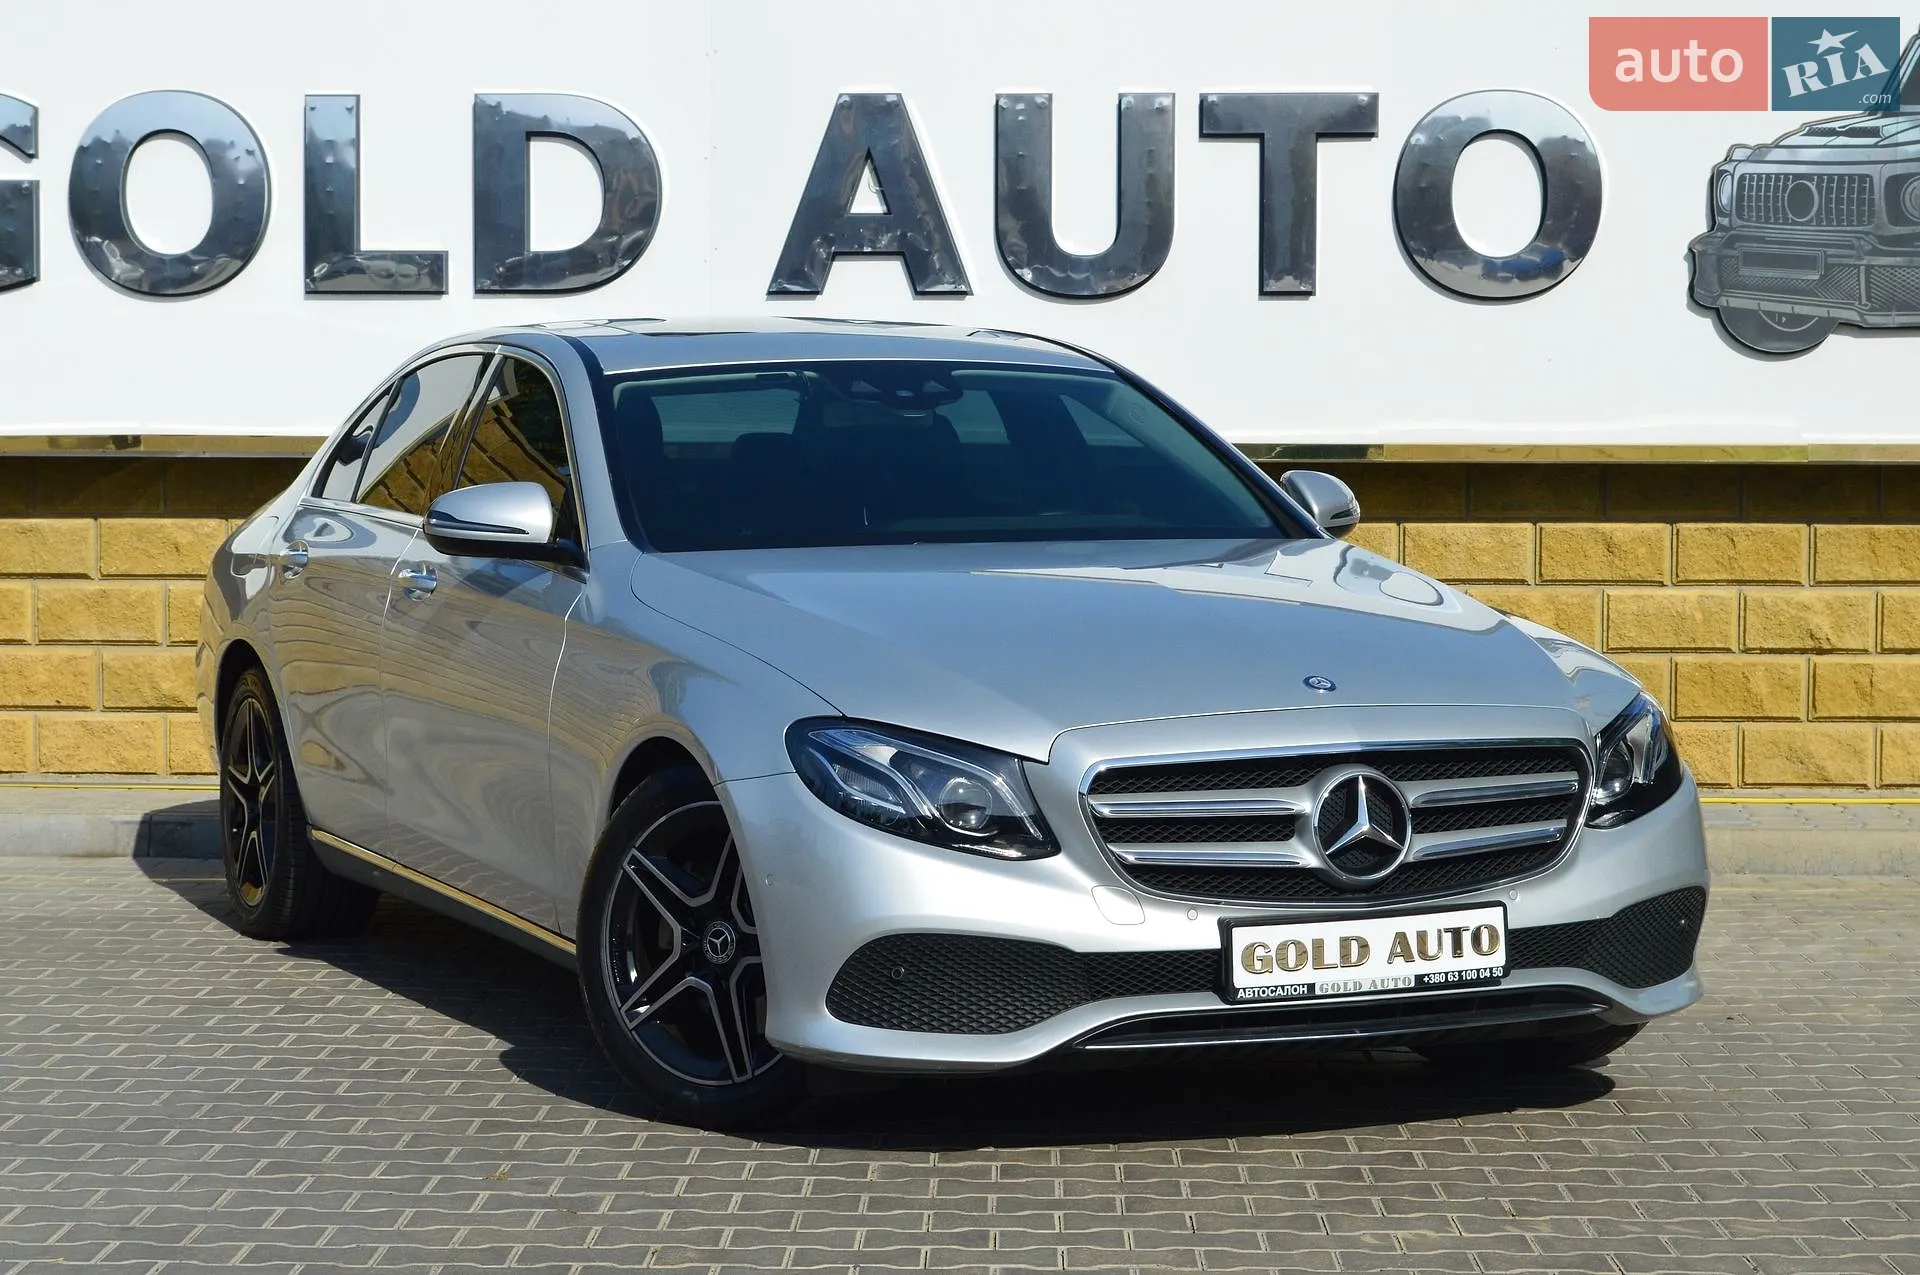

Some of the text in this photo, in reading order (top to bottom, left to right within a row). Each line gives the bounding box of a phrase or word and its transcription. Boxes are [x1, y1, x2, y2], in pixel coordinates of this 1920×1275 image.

[0, 89, 1603, 300] OLD AUTO
[1241, 923, 1501, 975] GOLD AUTO
[1423, 966, 1503, 984] +380 63 100 04 50
[1237, 985, 1308, 999] АВТОСАЛОН
[1318, 976, 1412, 995] GOLD AUTO
